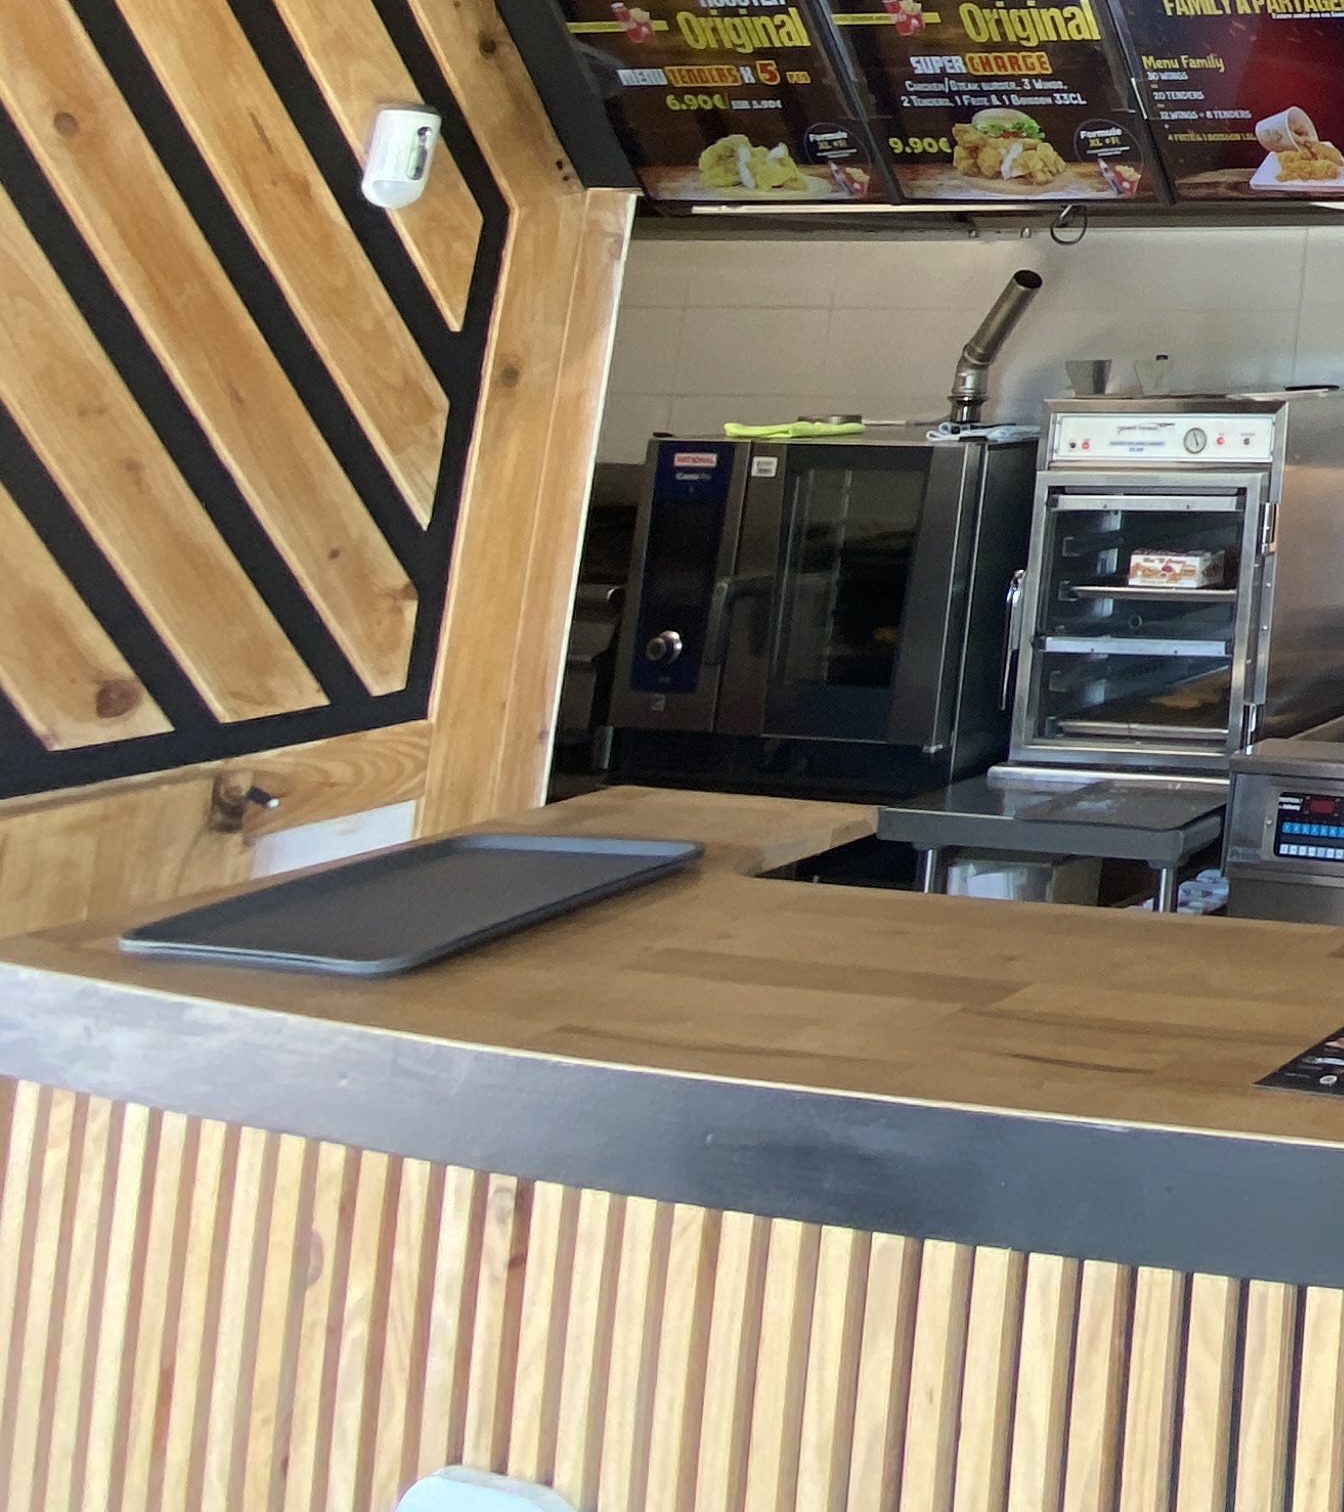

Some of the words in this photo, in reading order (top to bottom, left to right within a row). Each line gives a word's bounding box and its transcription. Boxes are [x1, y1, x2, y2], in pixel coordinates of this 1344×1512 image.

[676, 8, 811, 54] Original
[959, 0, 1100, 47] Original
[755, 60, 780, 85] 5
[910, 55, 967, 74] SUPER
[965, 51, 1052, 76] CHARGE
[1142, 55, 1179, 69] Menu
[1180, 53, 1225, 72] Family
[666, 94, 728, 111] 6.90€
[888, 137, 952, 154] 9.90€
